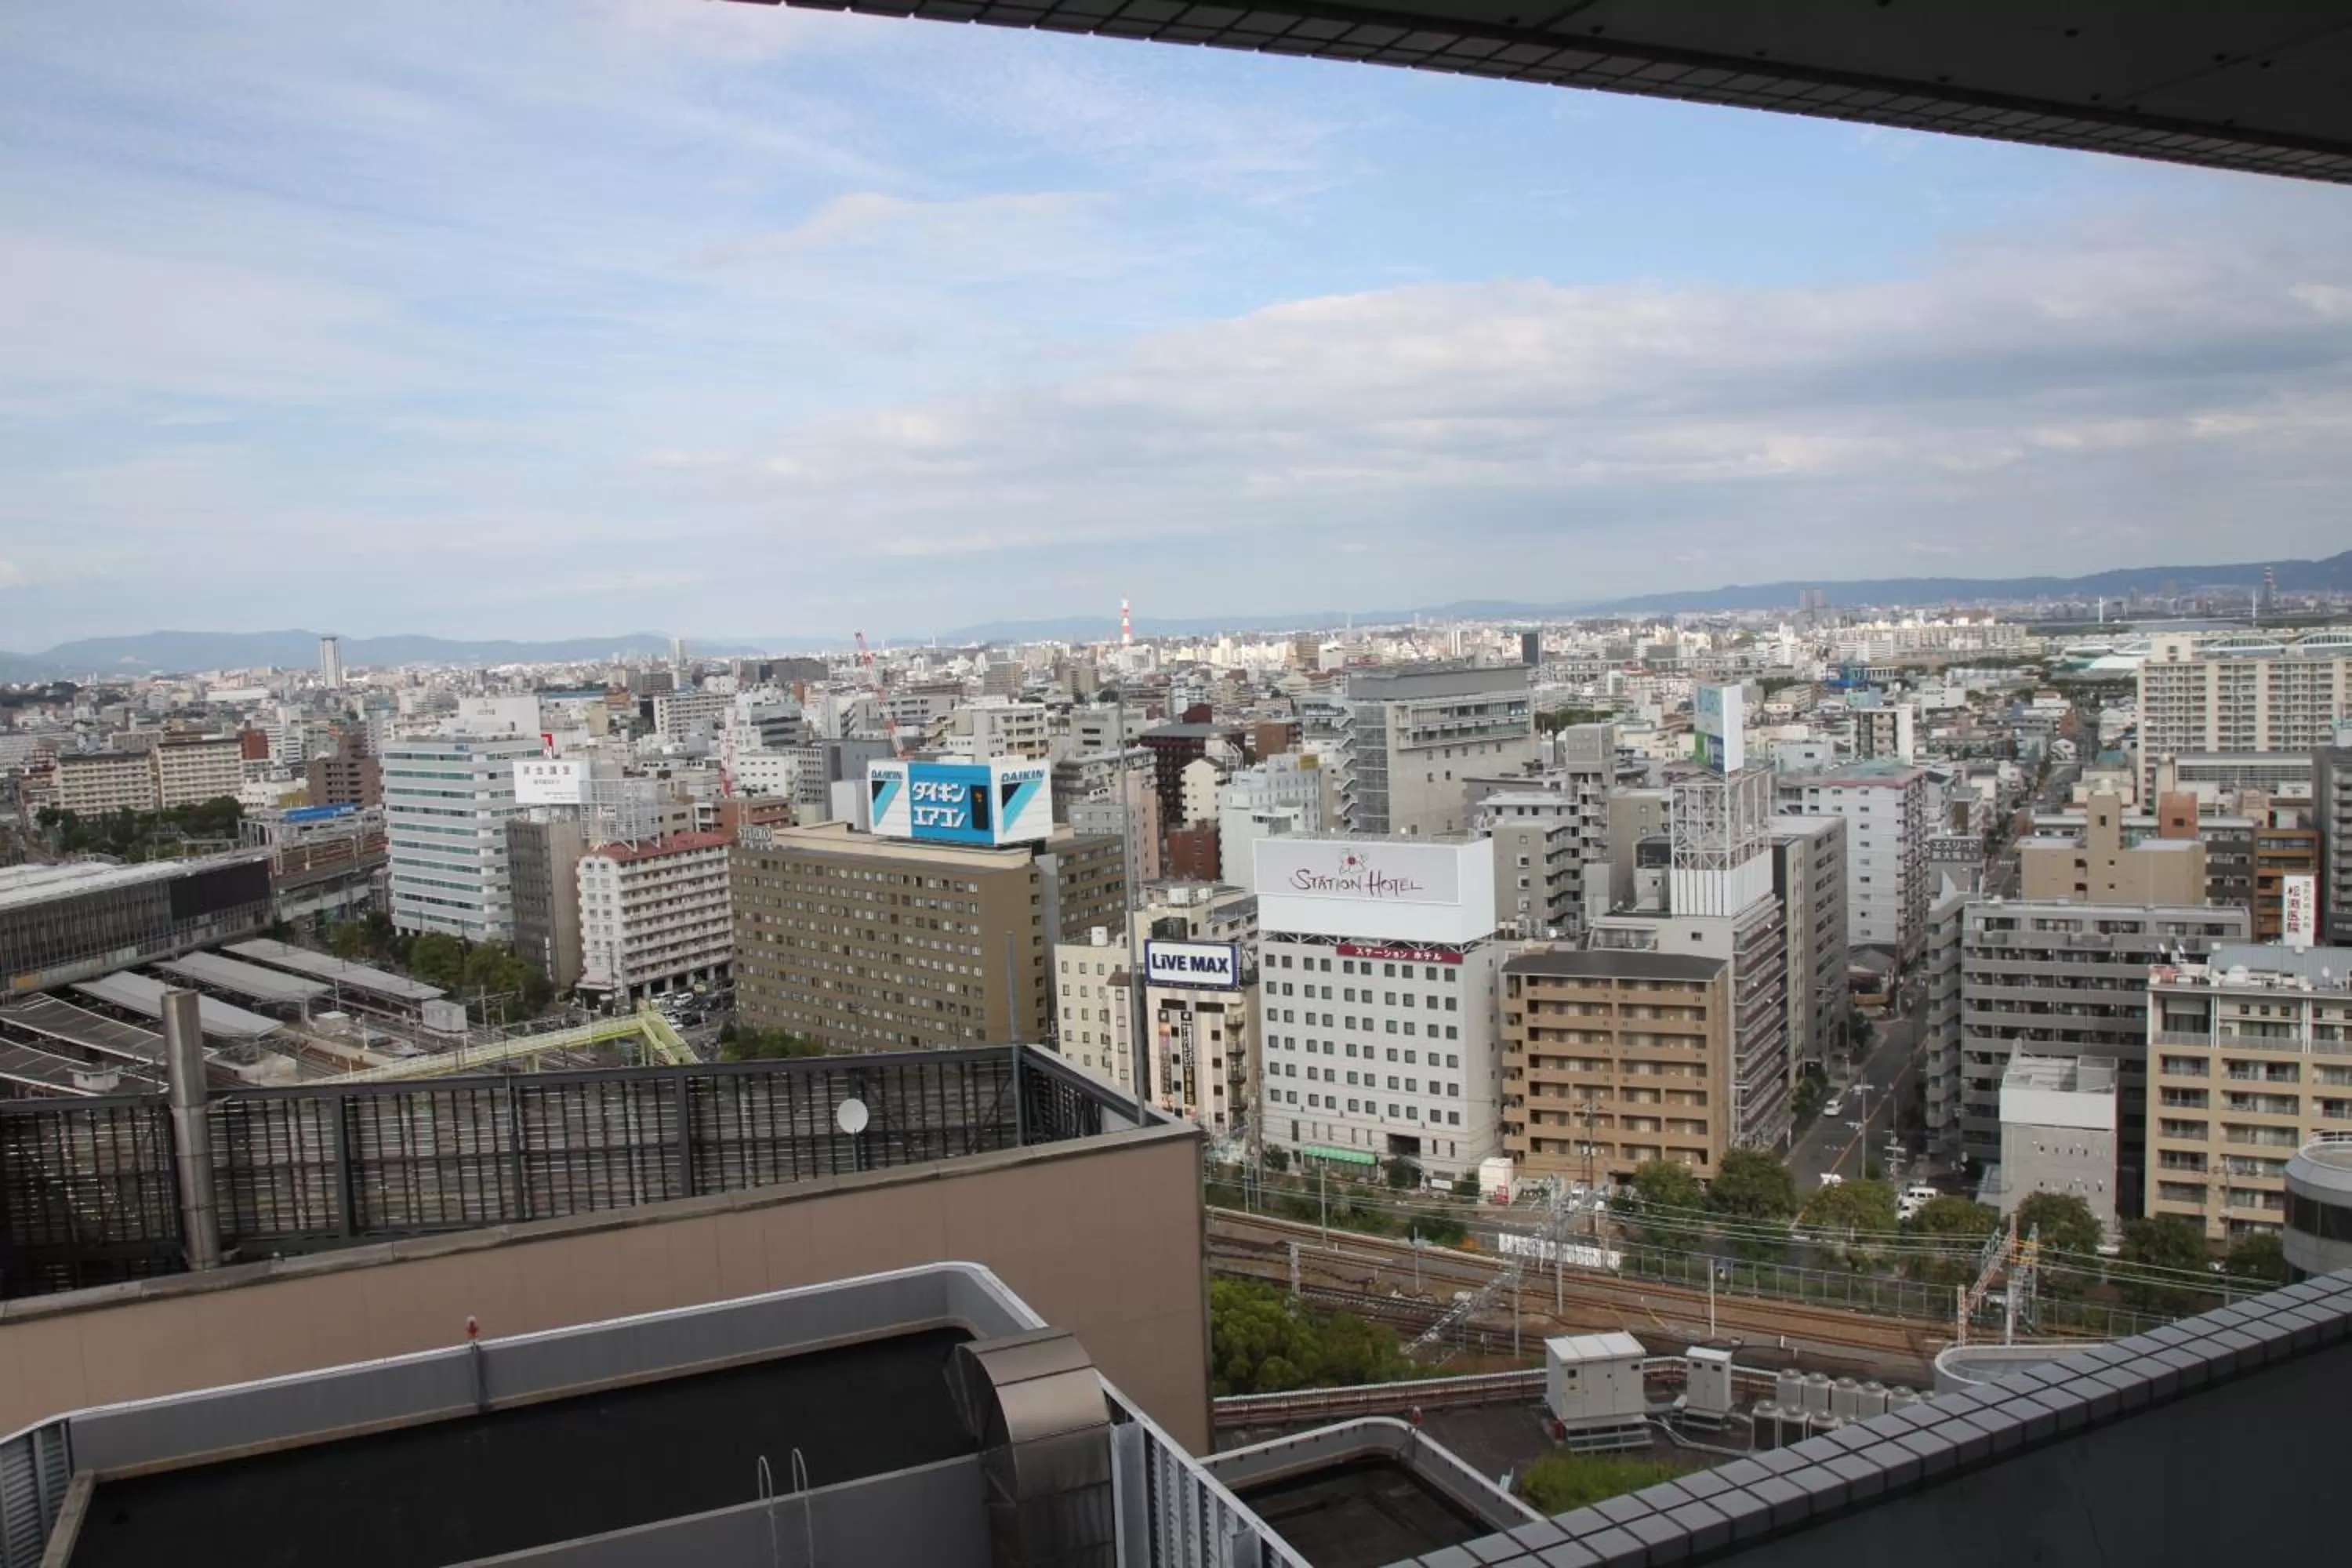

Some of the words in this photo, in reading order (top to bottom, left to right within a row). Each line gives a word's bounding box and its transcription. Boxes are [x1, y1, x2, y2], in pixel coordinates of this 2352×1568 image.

[871, 769, 902, 779] DAIKIN
[1001, 768, 1045, 782] DAIKIN
[913, 781, 965, 803] ダイキン
[913, 805, 966, 828] エアコン
[1364, 869, 1424, 898] HOTEL
[1190, 956, 1229, 974] MAX
